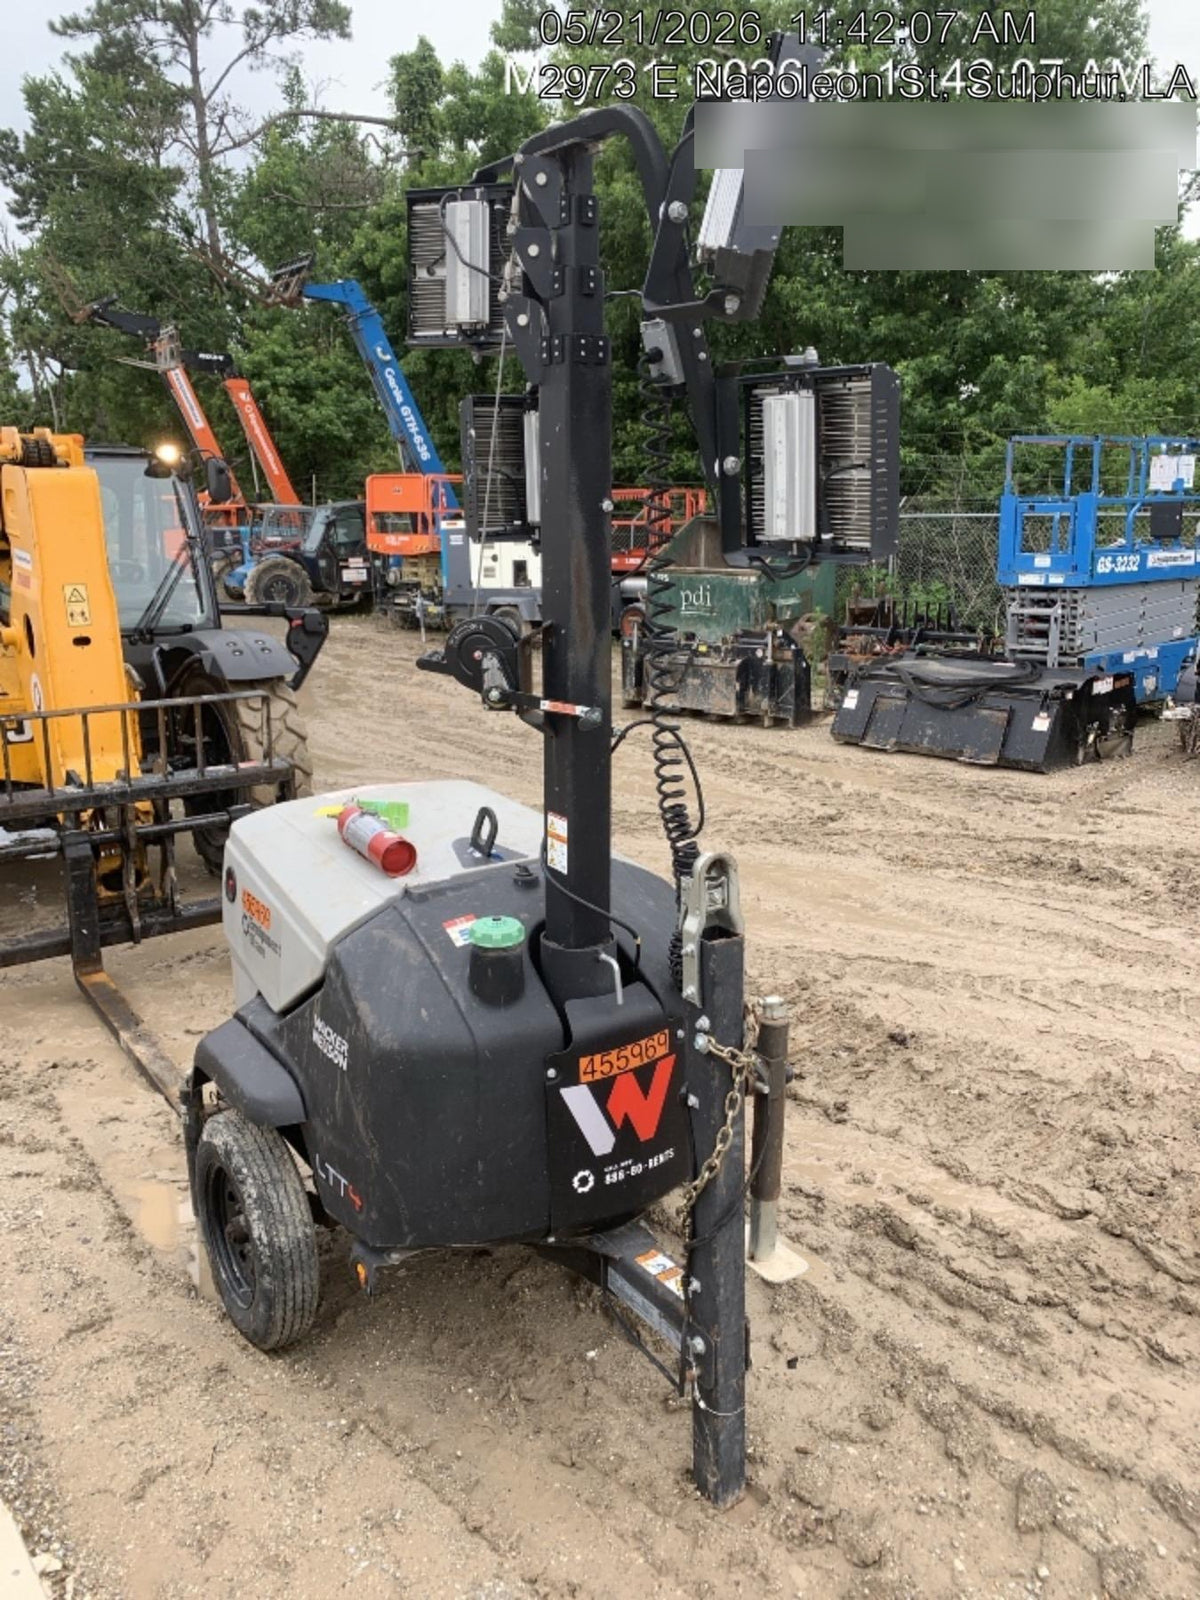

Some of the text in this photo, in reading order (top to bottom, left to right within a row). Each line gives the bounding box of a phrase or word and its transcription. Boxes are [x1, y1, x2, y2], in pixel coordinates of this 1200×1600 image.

[680, 584, 712, 611] pdi
[314, 1014, 349, 1057] WACKER
[582, 1031, 668, 1080] 455969
